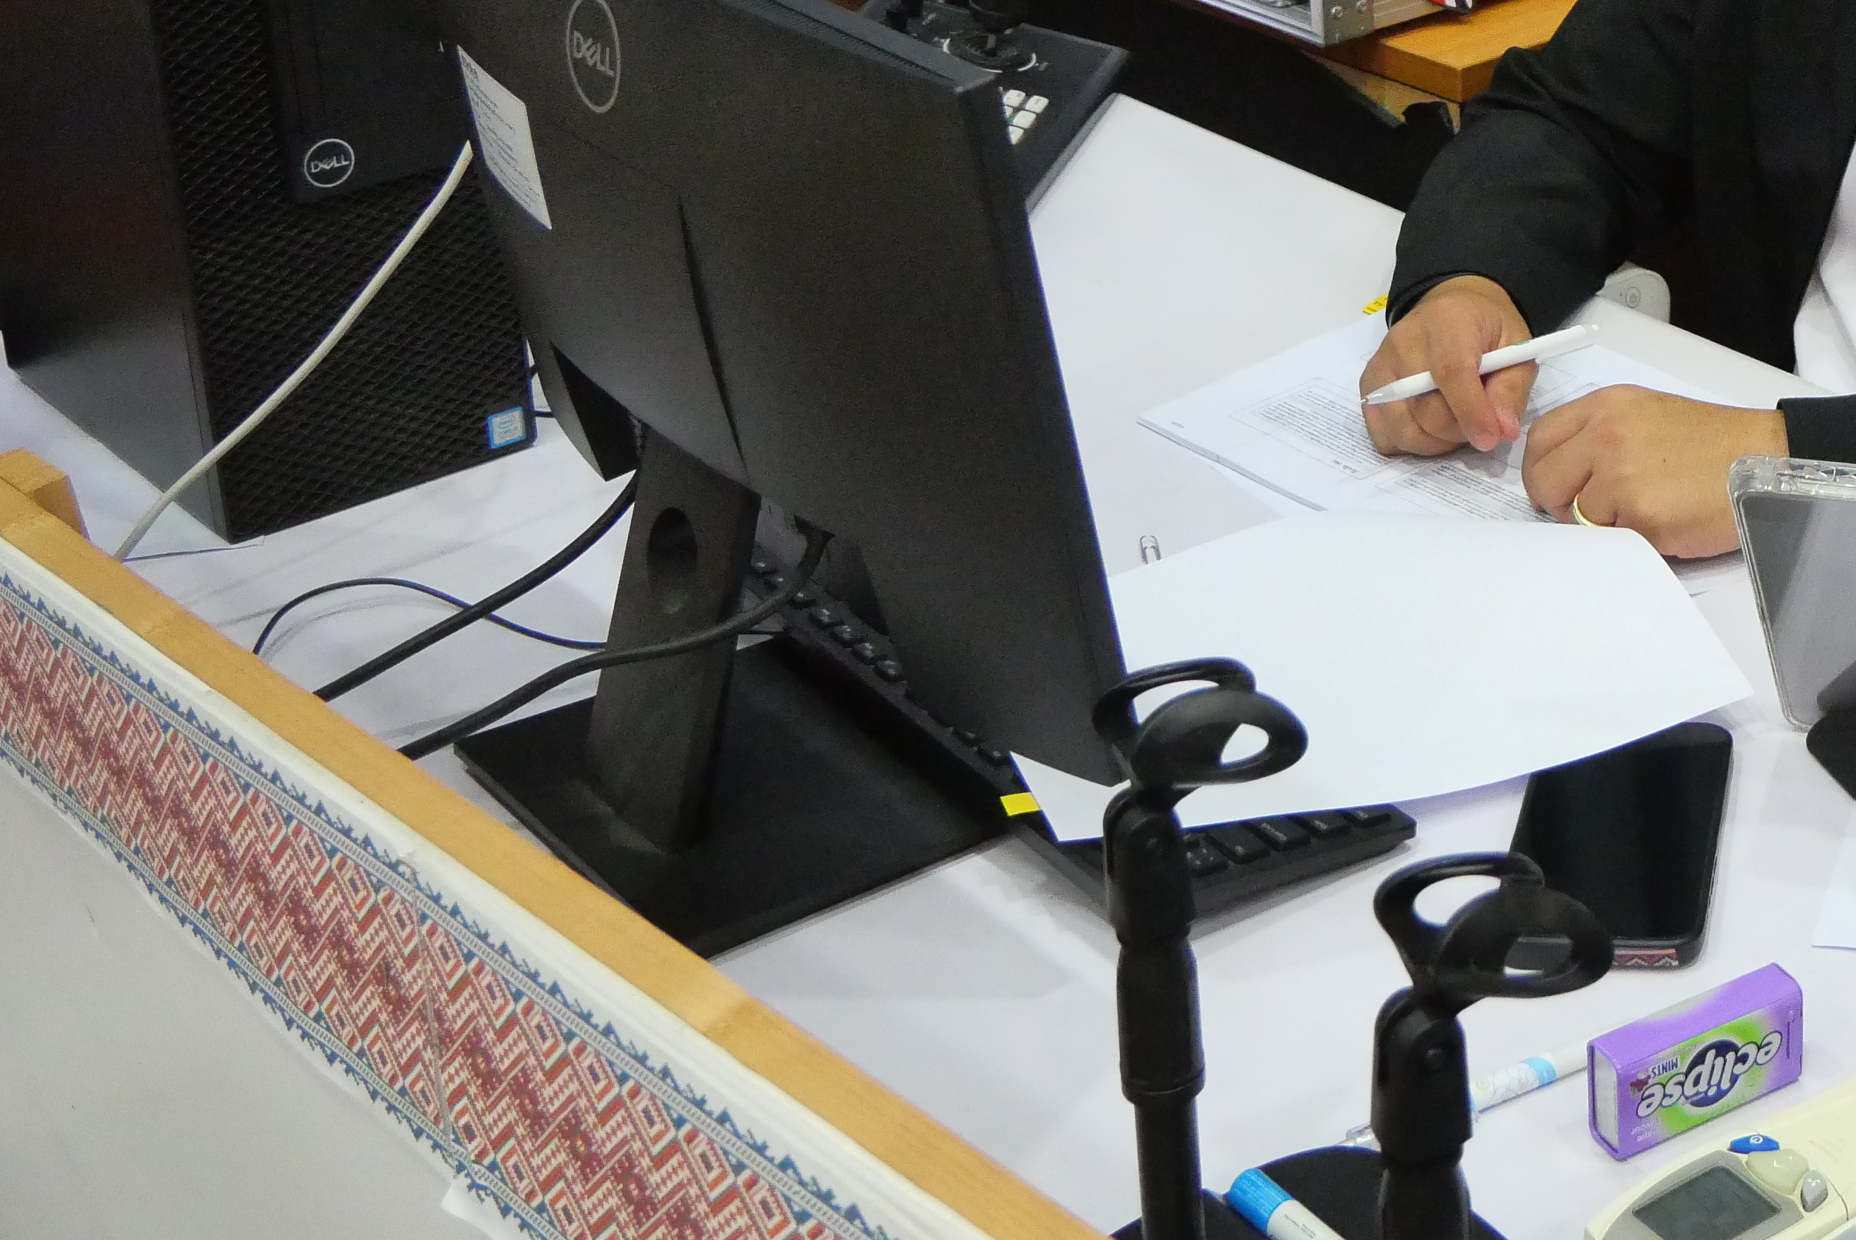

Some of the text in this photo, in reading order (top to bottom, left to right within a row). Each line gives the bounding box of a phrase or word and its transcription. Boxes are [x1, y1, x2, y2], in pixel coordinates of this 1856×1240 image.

[574, 29, 615, 78] DELL
[311, 154, 350, 173] DELL
[1636, 1030, 1783, 1119] eclipse
[1651, 1057, 1679, 1079] MINTS
